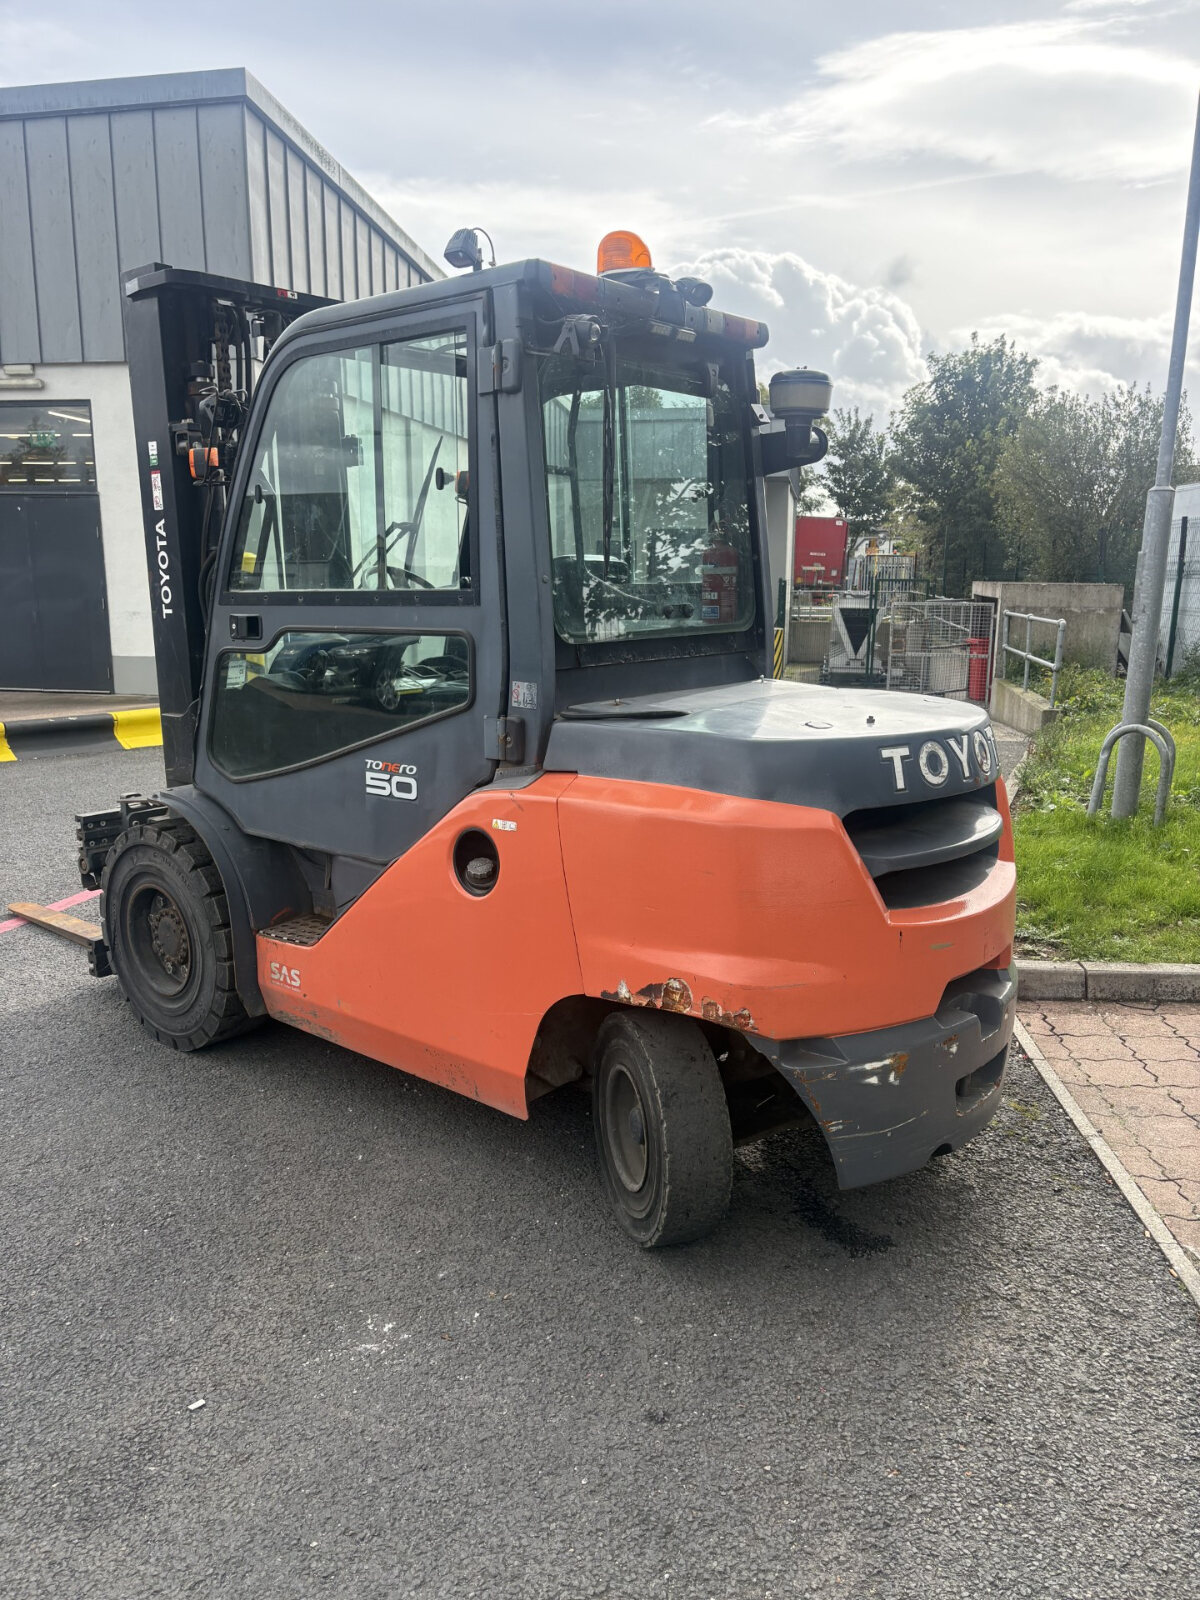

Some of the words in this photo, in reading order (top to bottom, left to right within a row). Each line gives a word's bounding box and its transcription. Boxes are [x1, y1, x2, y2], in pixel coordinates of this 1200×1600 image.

[155, 518, 173, 619] TOYOTA
[366, 771, 418, 800] 50
[270, 962, 301, 987] SAS
